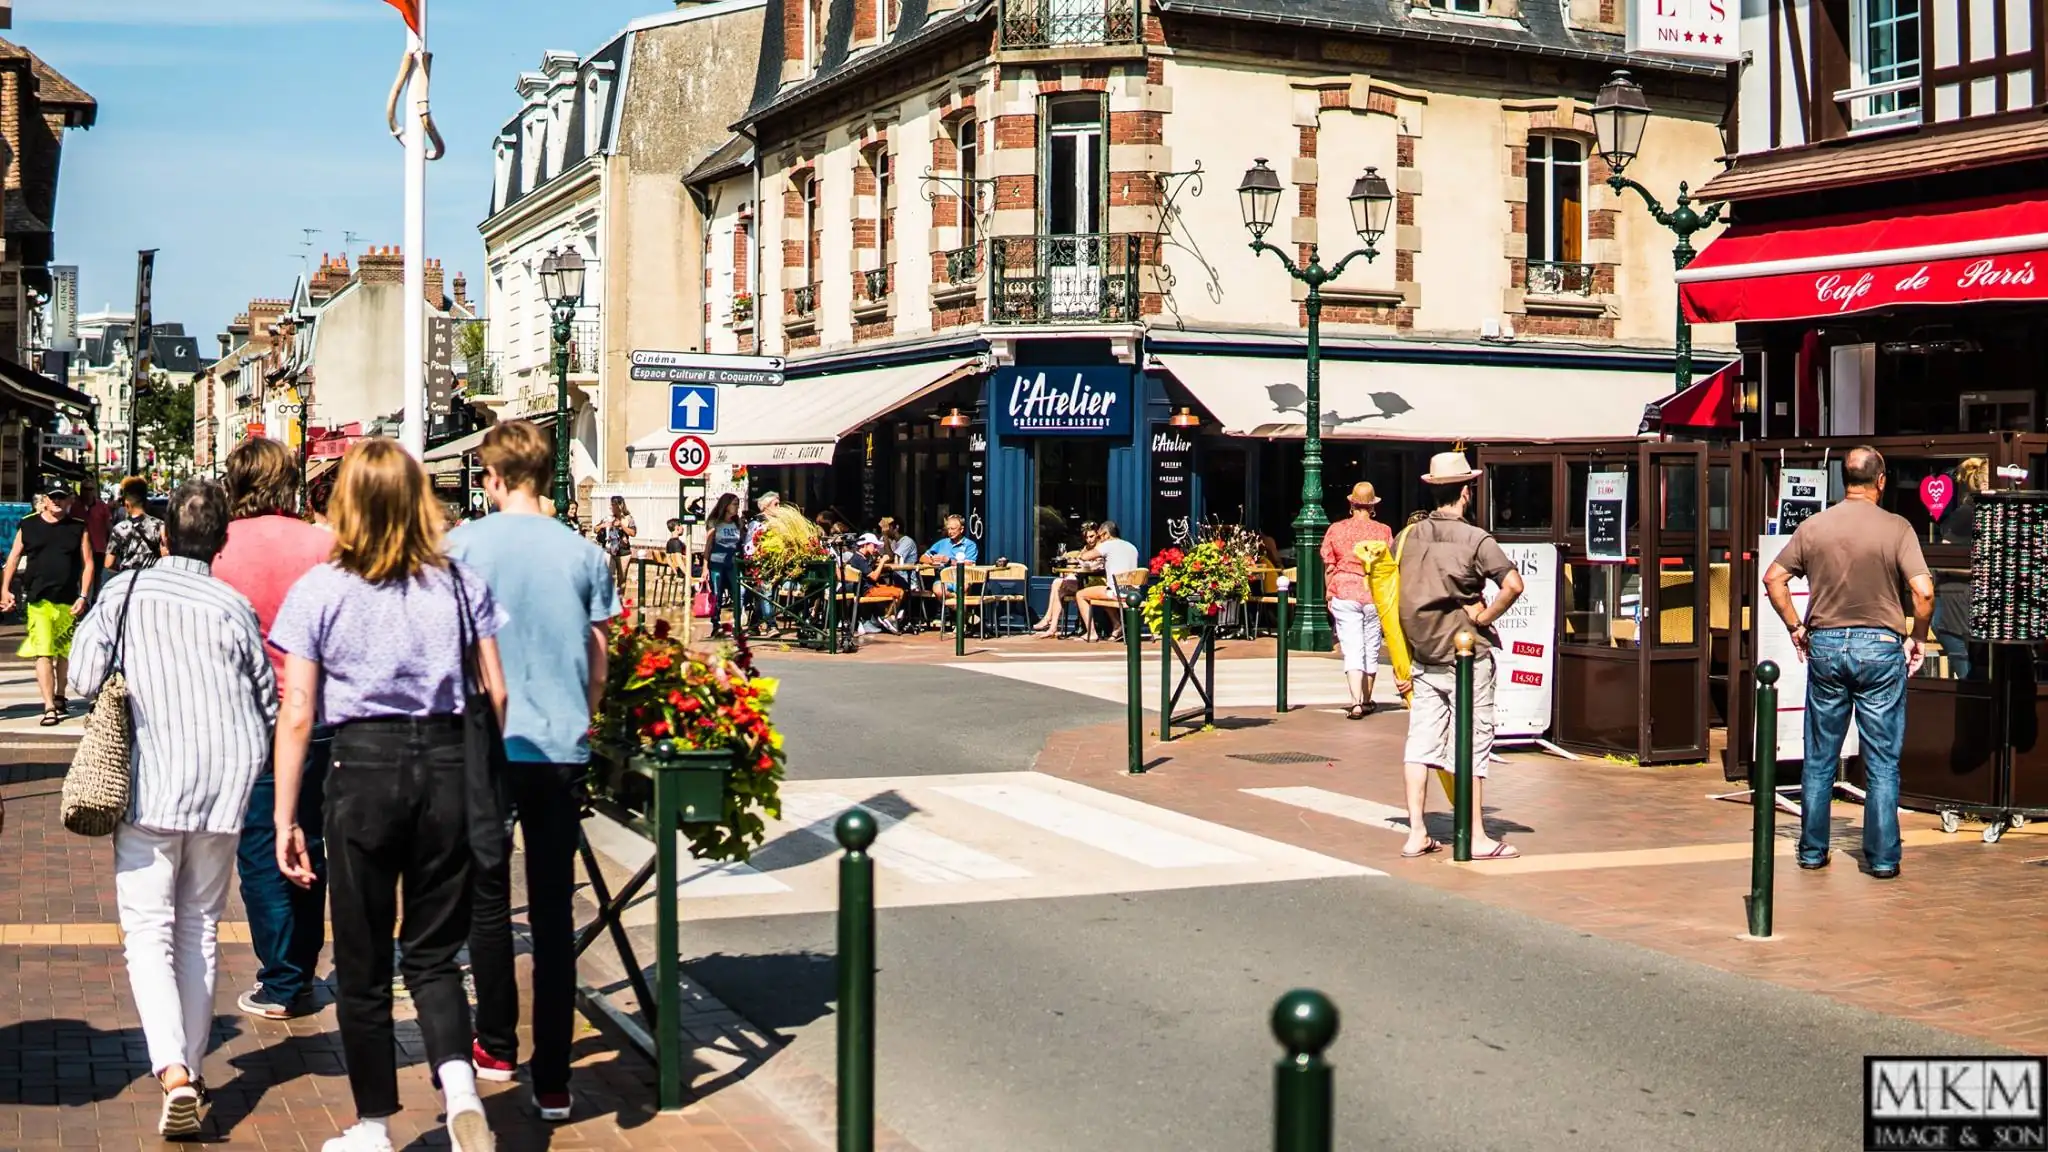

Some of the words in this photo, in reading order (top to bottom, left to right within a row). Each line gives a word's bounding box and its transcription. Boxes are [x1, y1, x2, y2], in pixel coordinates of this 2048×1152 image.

[1658, 28, 1679, 42] NN
[60, 271, 68, 312] AGENCES
[1815, 272, 1875, 311] Café
[1895, 265, 1930, 292] de
[1957, 259, 2036, 288] Paris
[68, 271, 77, 338] D'AUJOURD'HUI
[635, 353, 677, 364] Cinéma
[634, 367, 666, 379] Espace
[669, 369, 706, 380] Culturel
[720, 371, 765, 383] Coquatrix
[1009, 372, 1117, 417] l'Atelier
[1152, 432, 1192, 452] l'Atelier
[678, 447, 702, 465] 30
[1523, 549, 1538, 560] de
[1516, 644, 1535, 655] 13,50
[1515, 672, 1535, 684] 14,50
